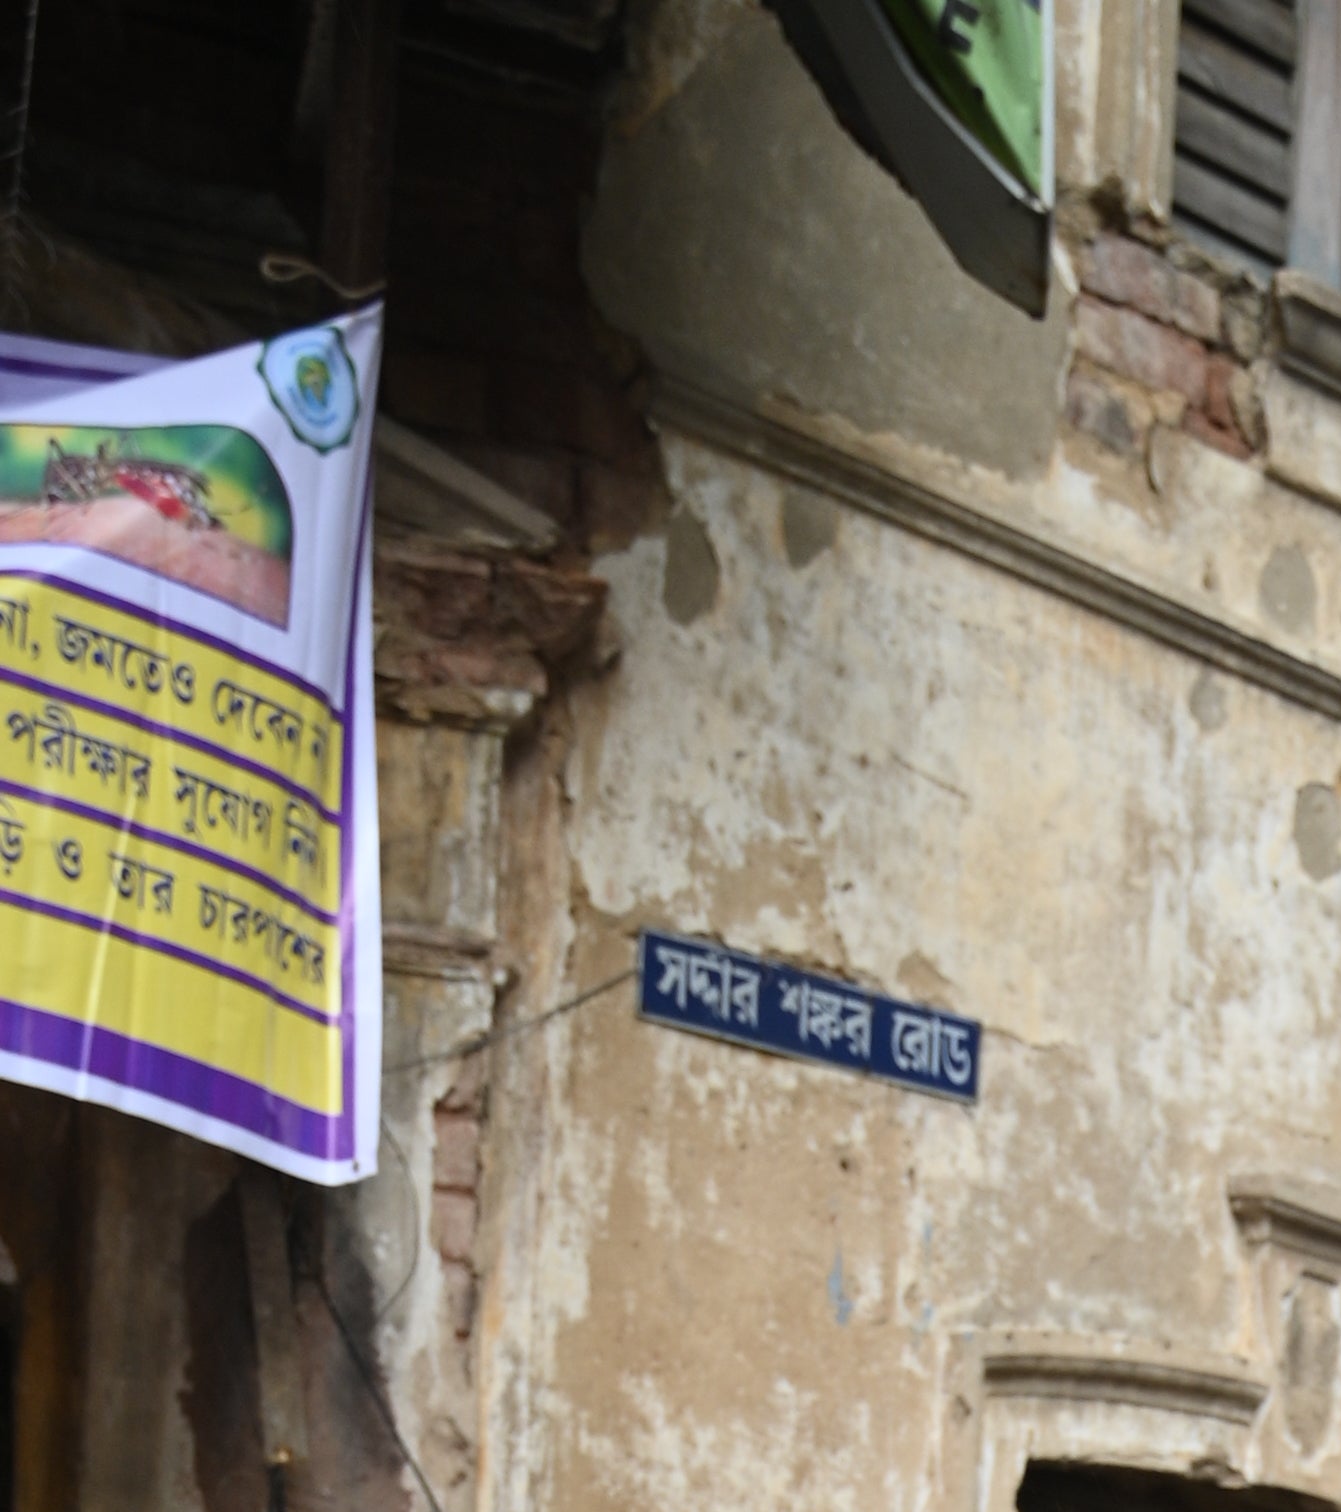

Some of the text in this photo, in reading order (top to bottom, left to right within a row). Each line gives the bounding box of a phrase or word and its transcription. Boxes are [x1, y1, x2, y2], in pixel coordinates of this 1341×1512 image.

[55, 614, 197, 704] জমতেও
[6, 703, 152, 799] পরীক্ষার
[173, 766, 273, 850] সুযোগ
[109, 851, 176, 916] তার
[198, 881, 326, 986] চারপাশের
[778, 978, 874, 1059] শঙ্কর
[890, 1009, 972, 1086] রোড
